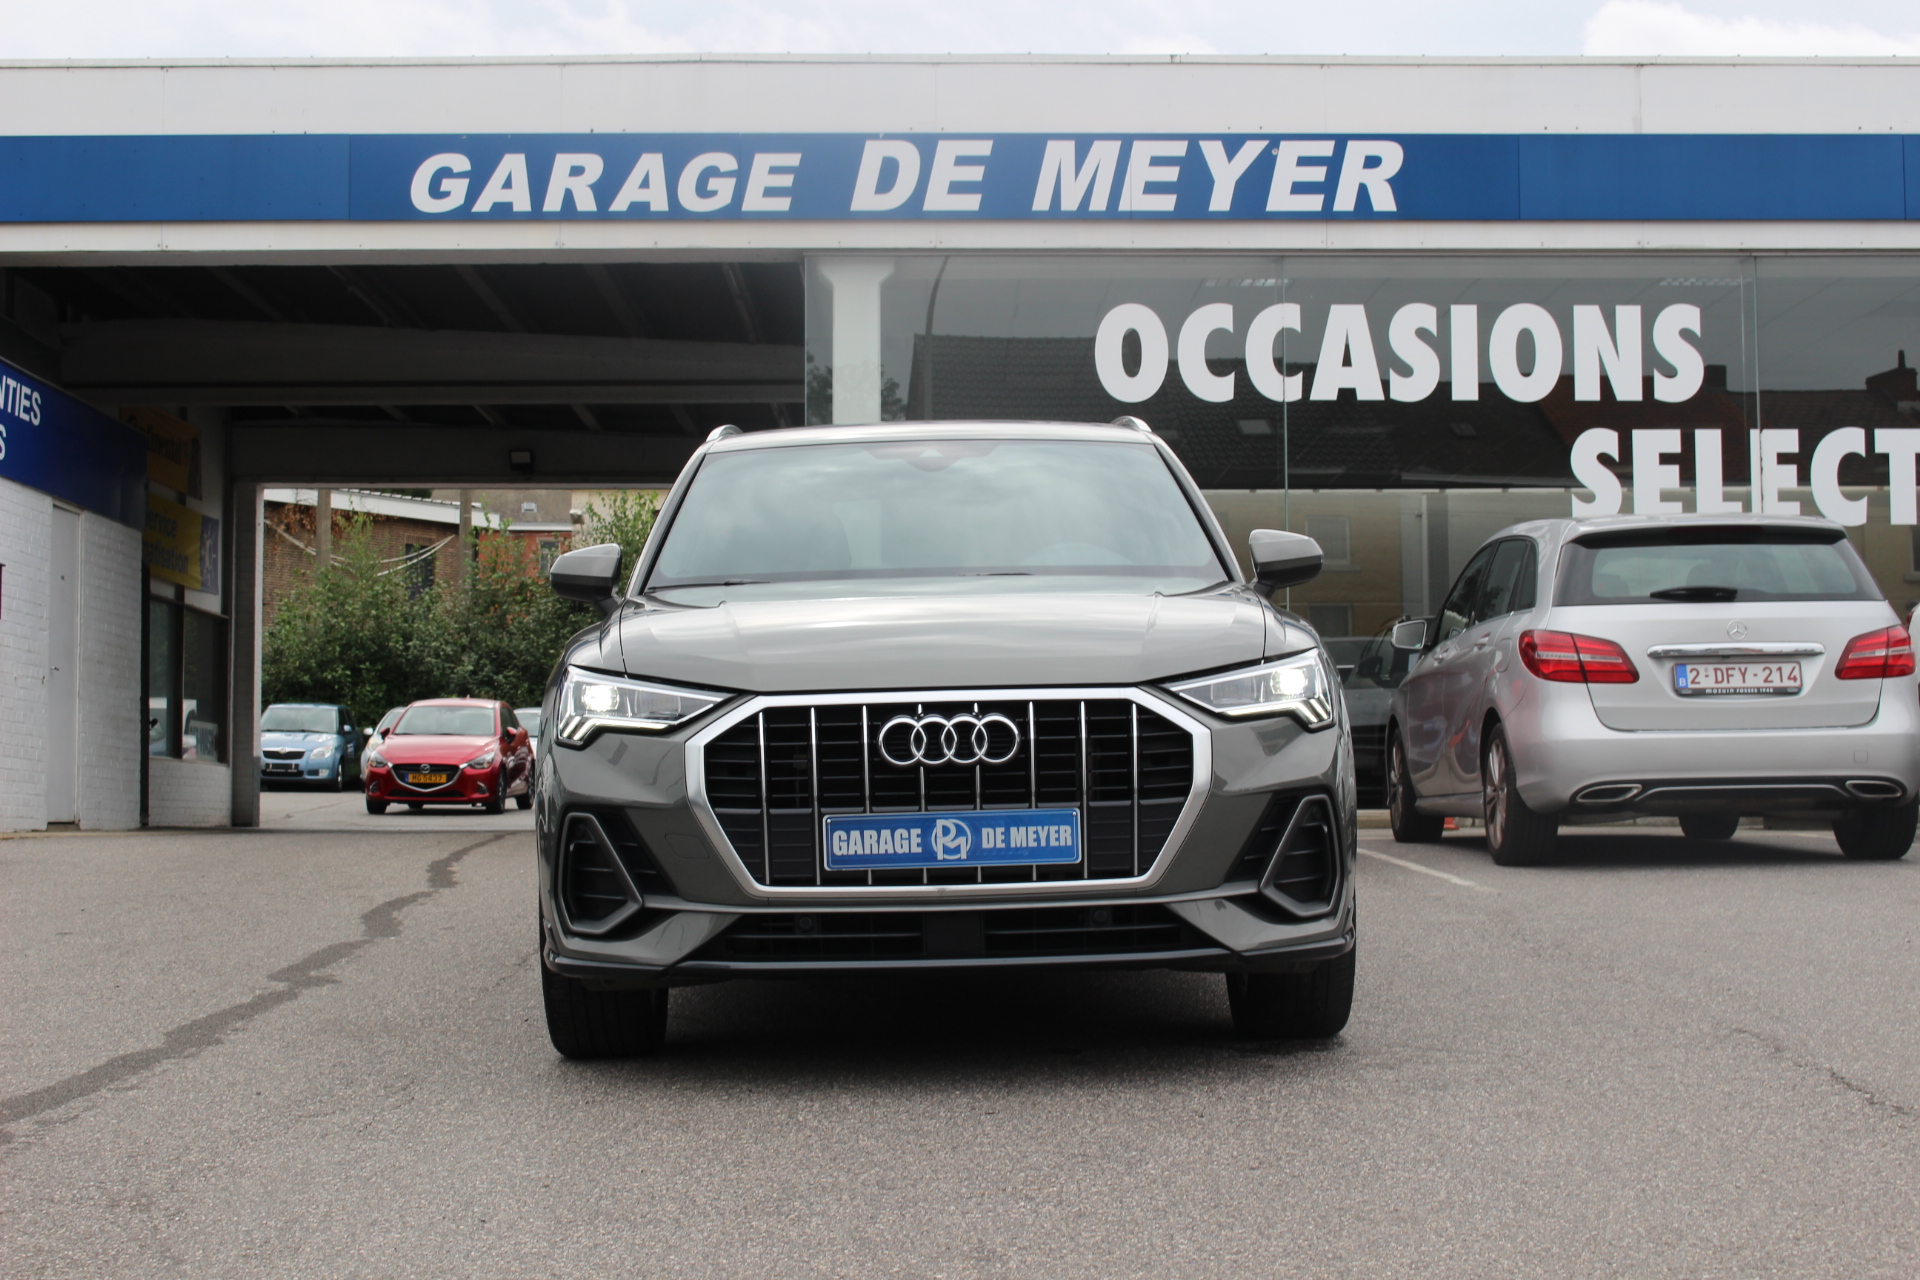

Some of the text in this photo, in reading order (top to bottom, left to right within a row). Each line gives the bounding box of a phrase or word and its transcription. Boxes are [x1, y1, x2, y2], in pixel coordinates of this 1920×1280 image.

[410, 140, 1404, 213] GARAGE DE MEYER
[1094, 302, 1704, 403] OCCASIONS
[1570, 426, 1920, 526] SELECT
[1689, 666, 1798, 685] 2-DFY-214
[832, 828, 922, 856] GARAGE
[981, 827, 1005, 849] DE
[1010, 825, 1072, 848] MEYER
